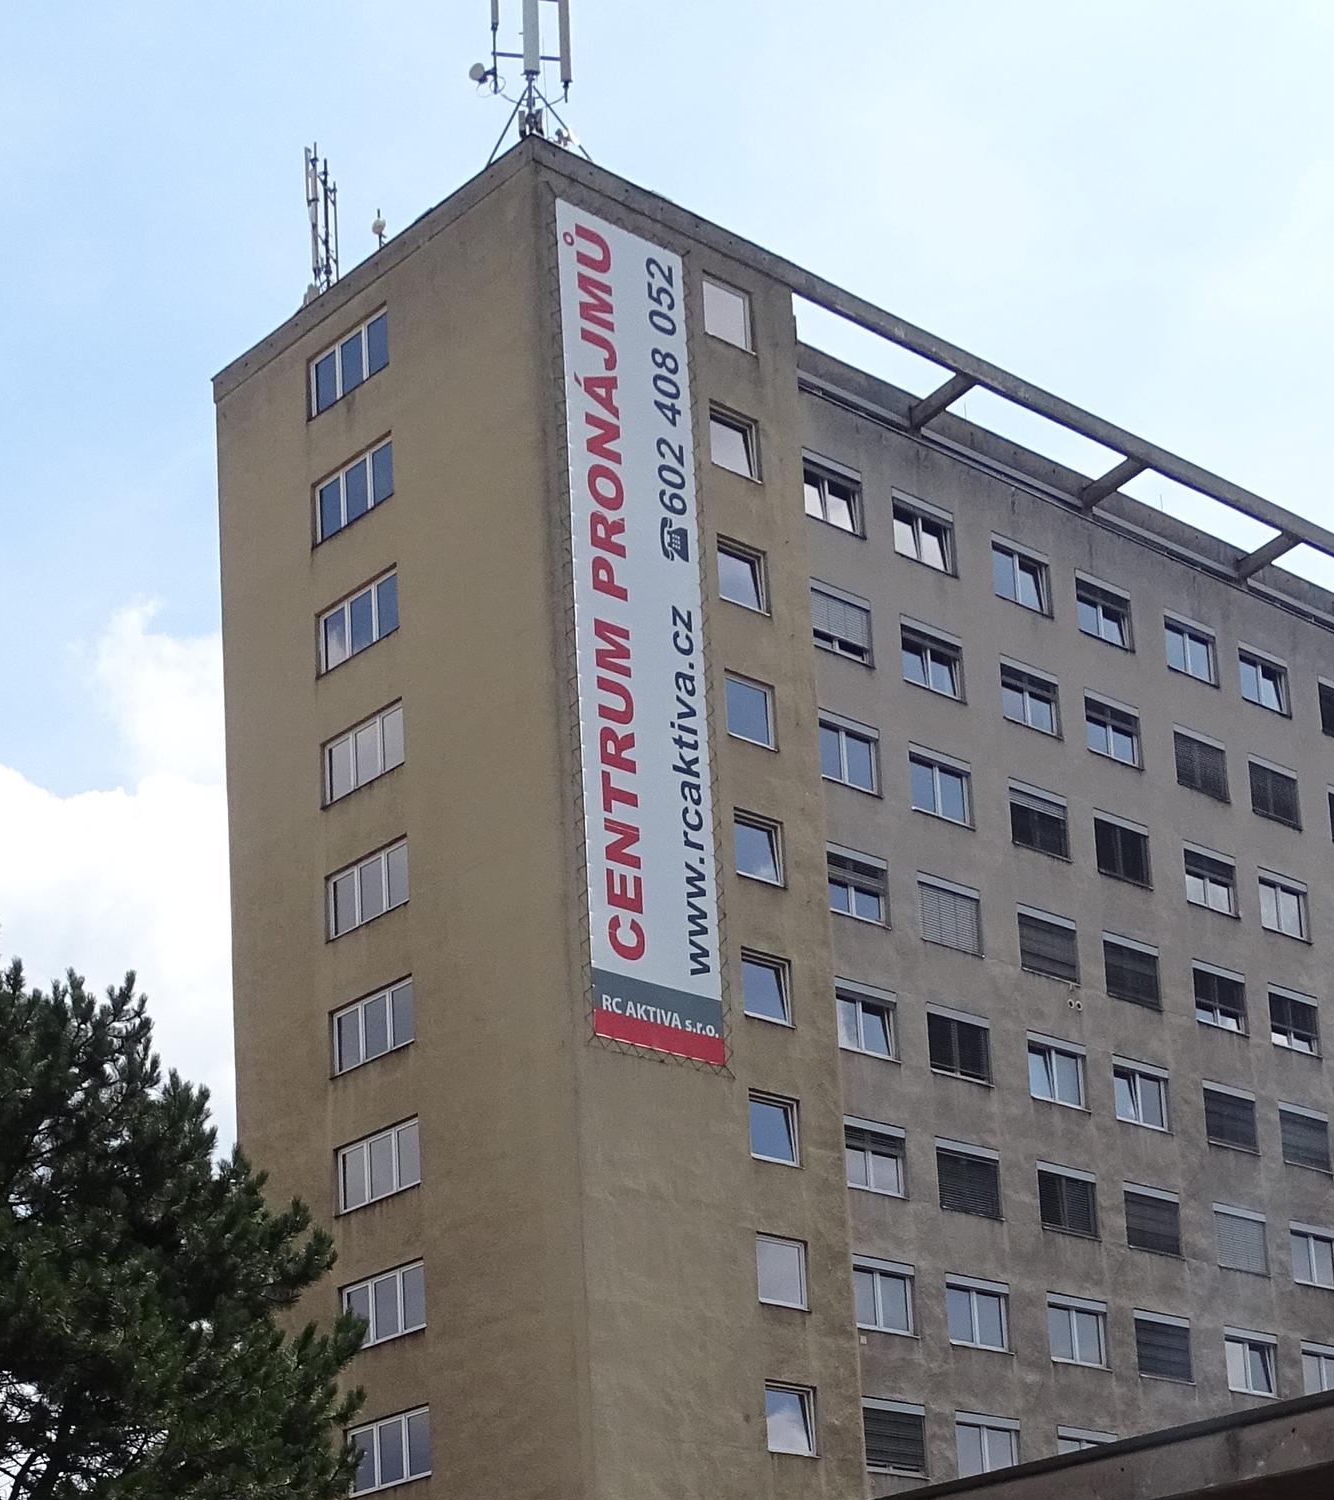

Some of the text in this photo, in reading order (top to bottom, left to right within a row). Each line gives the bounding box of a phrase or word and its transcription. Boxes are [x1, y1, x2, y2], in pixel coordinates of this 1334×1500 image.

[563, 223, 646, 961] CENTRUM PRONÁJMŮ
[646, 257, 710, 976] www.rcaktiva.cz 602 408 052
[602, 994, 719, 1039] RC AKTIVA s.r.o.
